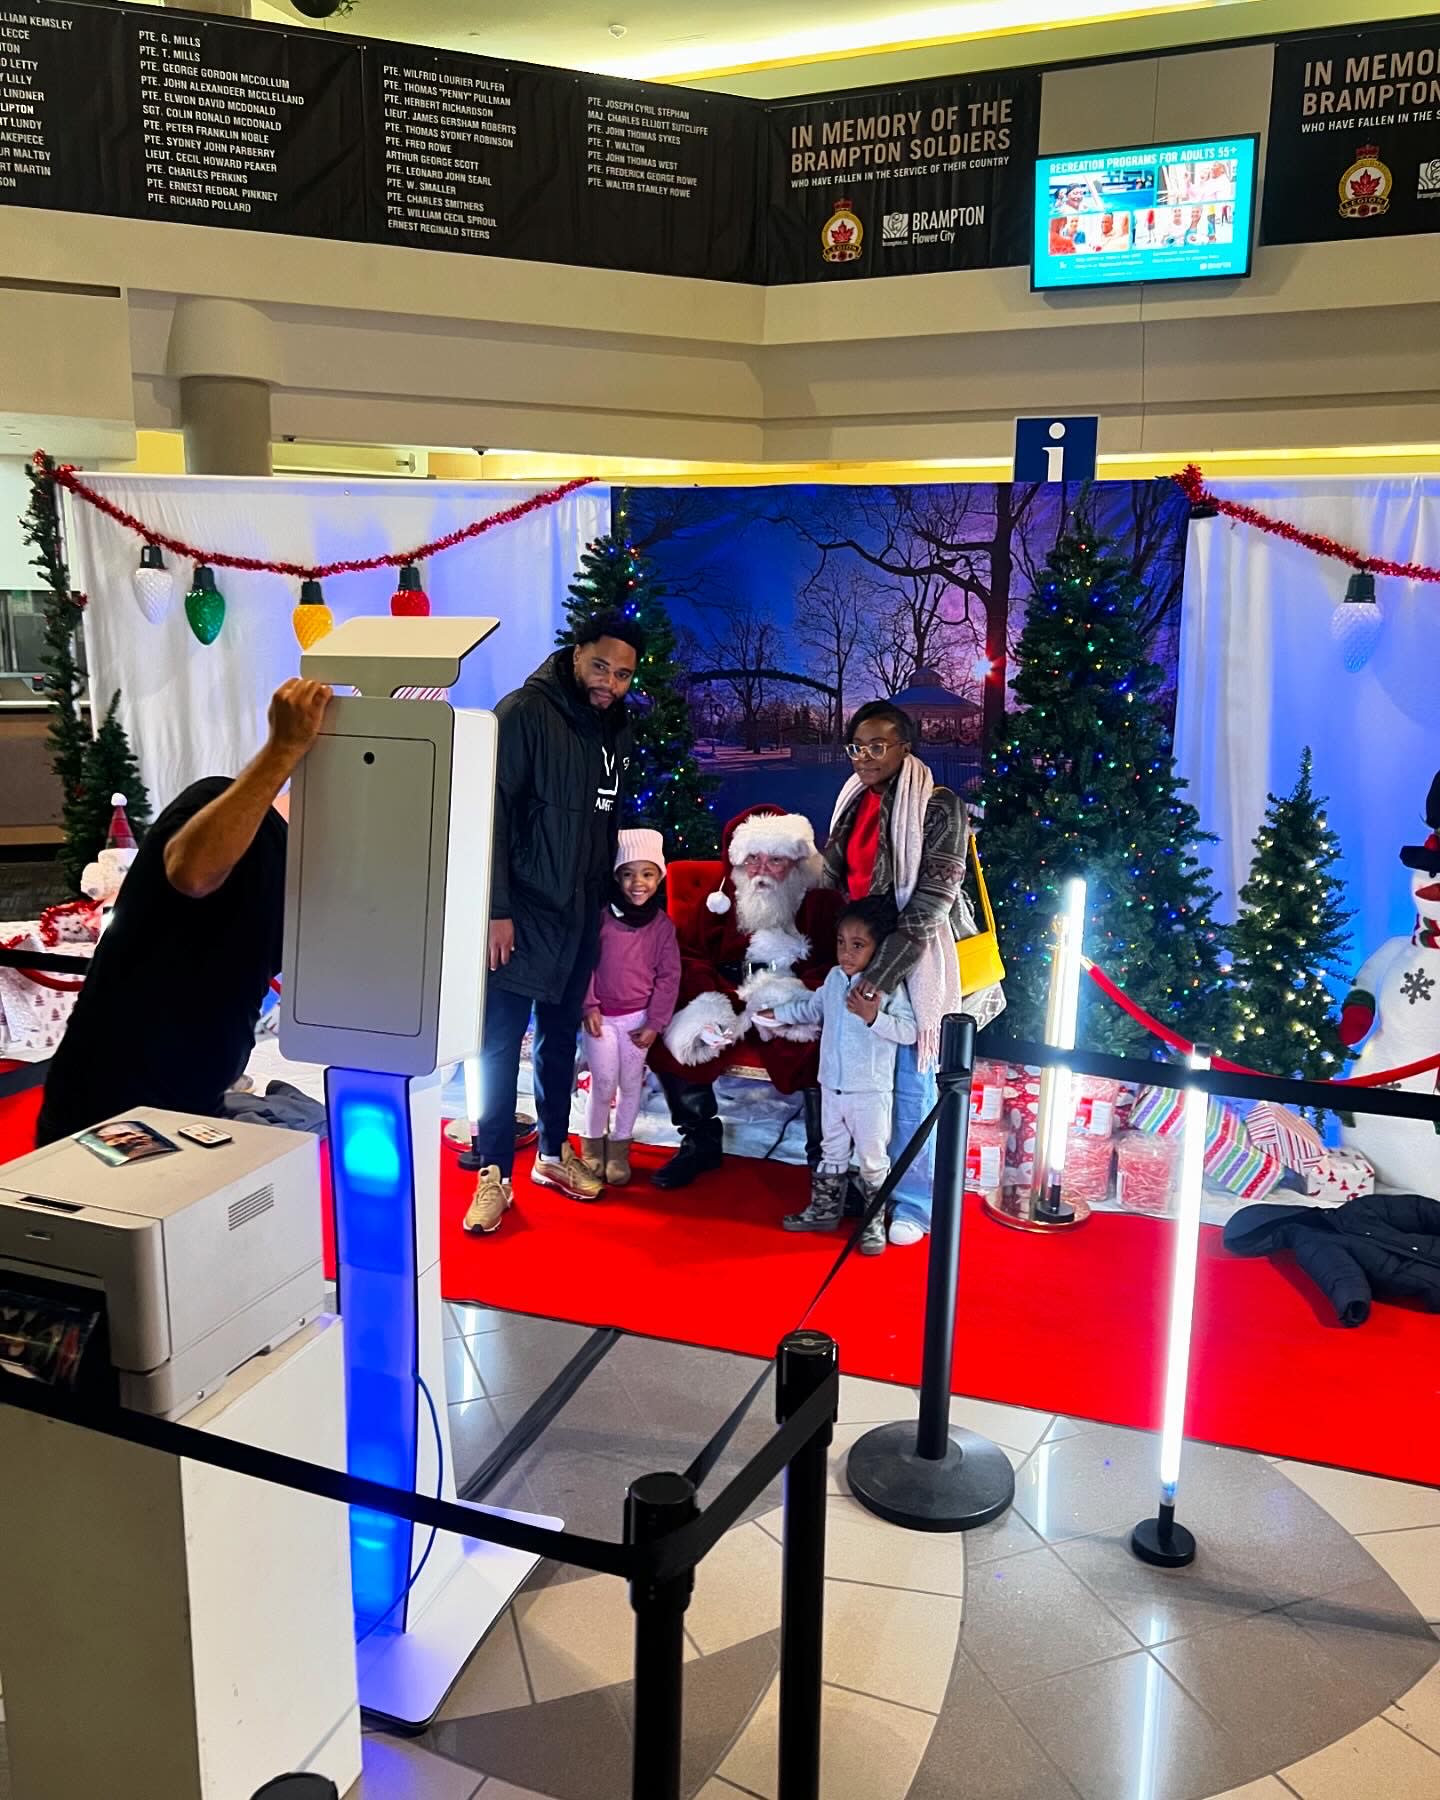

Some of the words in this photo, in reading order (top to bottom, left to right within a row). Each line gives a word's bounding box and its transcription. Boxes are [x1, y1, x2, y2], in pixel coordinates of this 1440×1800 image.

[30, 16, 73, 31] KEMSLEY
[1, 27, 30, 40] LECCE
[174, 35, 200, 47] MILLS
[10, 58, 39, 71] LETTY
[173, 50, 200, 62] MILLS
[163, 63, 200, 76] GEORGE
[201, 68, 238, 81] GORDON
[241, 74, 289, 88] MCCOLLUM
[1304, 60, 1333, 87] IN
[1345, 49, 1440, 83] MEMO
[7, 73, 32, 85] LILLY
[404, 69, 438, 81] WILFRID
[476, 80, 504, 92] PULFER
[3, 88, 45, 101] LINDNER
[164, 78, 187, 89] JOHN
[248, 90, 304, 105] MCCLELLAND
[404, 83, 439, 95] THOMAS
[472, 93, 510, 105] PULLMAN
[0, 103, 34, 114] LIPTON
[164, 93, 197, 105] ELWON
[198, 97, 225, 108] DAVID
[228, 101, 275, 115] MCDONALD
[405, 97, 440, 109] HERBERT
[443, 103, 493, 116] RICHARDSON
[605, 100, 634, 111] JOSEPH
[635, 104, 657, 115] CYRIL
[658, 108, 689, 119] STEPHAN
[11, 117, 42, 130] LUNDY
[166, 108, 194, 119] COLIN
[195, 111, 230, 124] RONALD
[234, 117, 281, 130] MCDONALD
[413, 113, 440, 124] JAMES
[482, 122, 516, 134] ROBERTS
[608, 114, 641, 126] CHARLES
[792, 125, 812, 149] IN
[822, 111, 922, 145] MEMORY
[931, 106, 959, 131] OF
[968, 100, 1013, 127] THE
[1302, 122, 1324, 133] WHO
[1329, 119, 1355, 130] HAVE
[1358, 115, 1394, 127] FALLEN
[1398, 114, 1409, 123] IN
[1413, 111, 1432, 121] THE
[166, 123, 195, 133] PETER
[196, 126, 240, 140] FRANKLIN
[241, 132, 268, 144] NOBLE
[405, 125, 440, 138] THOMAS
[441, 130, 473, 142] SYDNEY
[474, 134, 513, 147] ROBINSON
[606, 127, 626, 136] JOHN
[627, 130, 658, 141] THOMAS
[659, 135, 680, 144] SYKES
[167, 137, 201, 149] SYDNEY
[204, 142, 227, 152] JOHN
[230, 145, 275, 158] PARBERRY
[406, 139, 427, 149] FRED
[792, 141, 900, 173] BRAMPTON
[910, 129, 1010, 160] SOLDIERS
[14, 163, 51, 176] MARTIN
[176, 153, 200, 164] CECIL
[204, 156, 242, 169] HOWARD
[245, 161, 276, 172] PEAKER
[386, 150, 420, 162] ARTHUR
[421, 155, 452, 167] GEORGE
[455, 160, 478, 170] SCOTT
[606, 153, 626, 163] JOHN
[627, 156, 658, 167] THOMAS
[659, 161, 677, 170] WEST
[1050, 159, 1104, 174] RECREATION
[1107, 155, 1156, 168] PROGRAMS
[1160, 152, 1177, 163] FOR
[1181, 148, 1215, 160] ADULTS
[1218, 147, 1237, 157] 55+
[169, 166, 208, 179] CHARLES
[211, 171, 247, 183] PERKINS
[406, 167, 444, 179] LEONARD
[445, 172, 467, 182] JOHN
[468, 175, 492, 186] SEARL
[606, 167, 646, 179] FREDERICK
[647, 172, 676, 183] GEORGE
[792, 179, 809, 188] WHO
[812, 177, 831, 186] HAVE
[834, 173, 862, 184] FALLEN
[876, 170, 891, 179] THE
[894, 166, 927, 177] SERVICE
[931, 164, 940, 173] OF
[943, 161, 966, 172] THEIR
[970, 157, 1009, 168] COUNTRY
[169, 181, 204, 193] ERNEST
[242, 189, 277, 201] PINKNEY
[420, 182, 456, 194] SMALLER
[606, 180, 636, 191] WALTER
[637, 184, 669, 194] STANLEY
[170, 196, 209, 208] RICHARD
[212, 200, 251, 212] POLLARD
[407, 195, 444, 206] CHARLES
[445, 199, 484, 211] SMITHERS
[407, 208, 443, 220] WILLIAM
[444, 213, 466, 223] CECIL
[467, 216, 496, 226] SPROUL
[913, 206, 984, 231] BRAMPTON
[388, 220, 418, 231] ERNEST
[421, 224, 460, 235] REGINALD
[461, 228, 489, 239] STEERS
[912, 233, 937, 244] Flower
[940, 230, 955, 243] City
